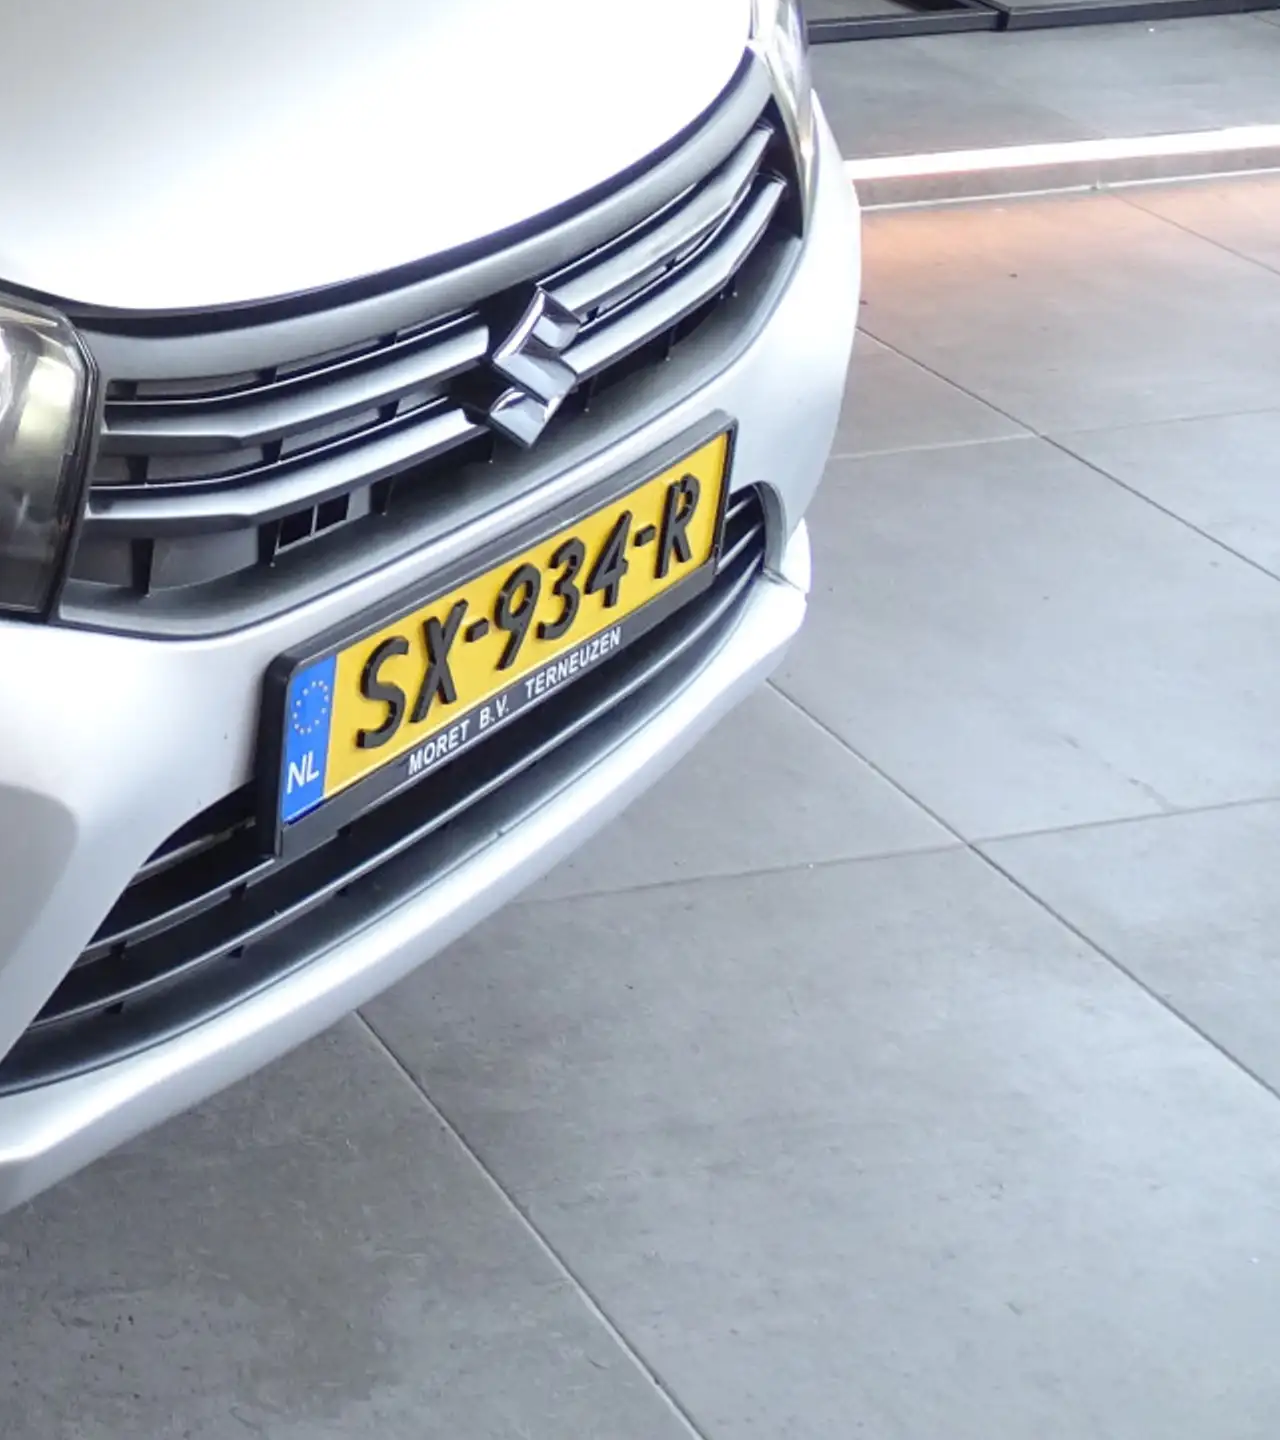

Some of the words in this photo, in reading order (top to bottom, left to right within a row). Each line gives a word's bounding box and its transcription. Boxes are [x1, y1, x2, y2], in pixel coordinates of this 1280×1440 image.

[356, 473, 701, 750] SX-934-R
[287, 751, 320, 794] NL
[408, 722, 470, 776] MORET
[479, 696, 510, 730] B.V.
[524, 627, 622, 700] TERNEUZEN
